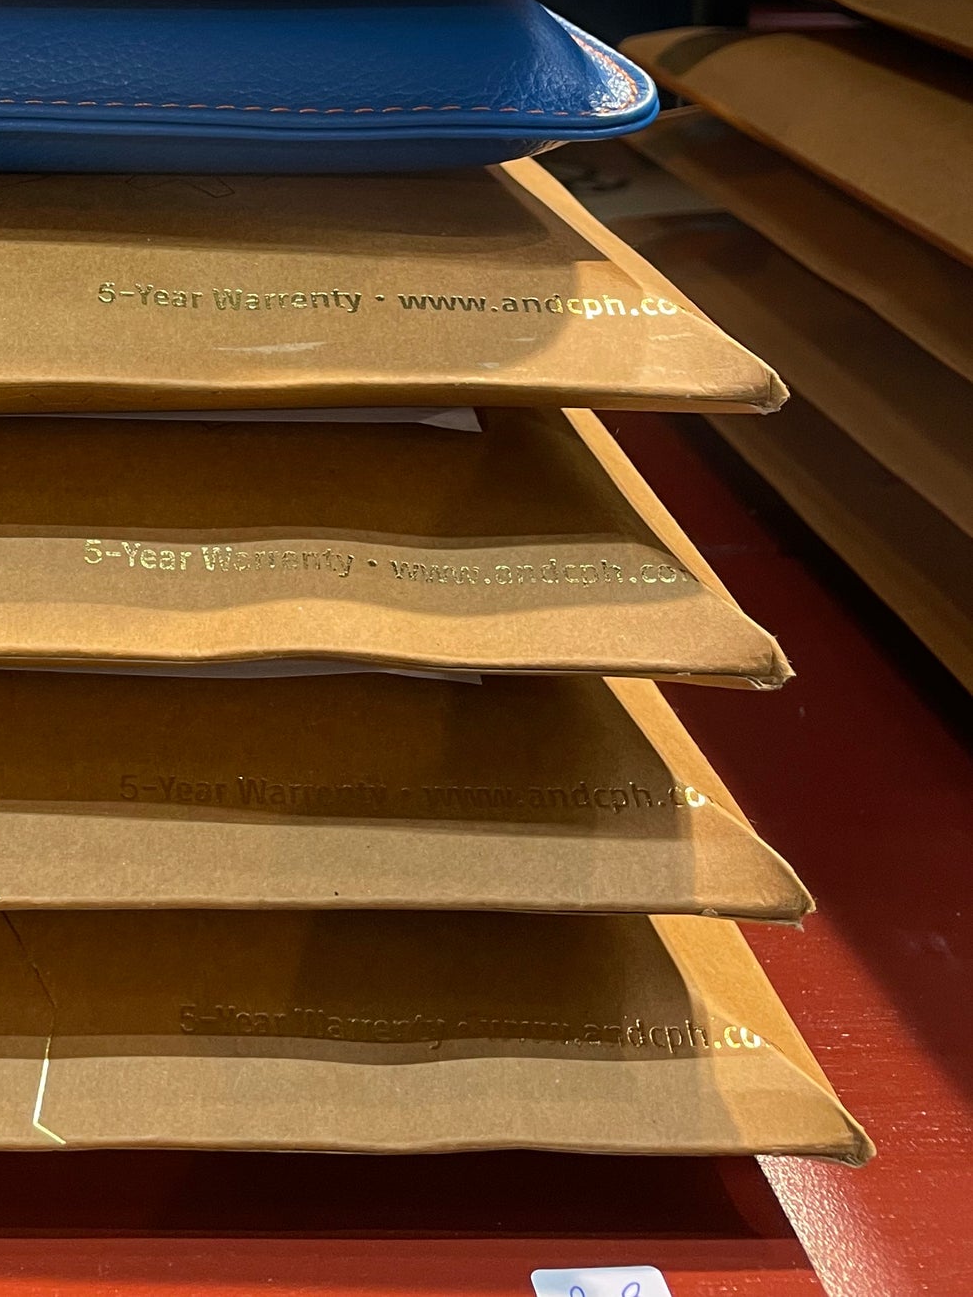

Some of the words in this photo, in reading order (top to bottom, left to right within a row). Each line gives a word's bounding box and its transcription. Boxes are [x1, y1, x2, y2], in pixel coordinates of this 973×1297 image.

[98, 281, 204, 308] 5-Year
[212, 287, 362, 314] Warrenty
[397, 293, 684, 320] www.andcph.co
[84, 538, 192, 571] 5-Year
[201, 545, 355, 577] Warrenty
[119, 774, 227, 804] 5-Year
[422, 781, 711, 813] www.andcph.co
[479, 1017, 769, 1054] www.andcph.co
